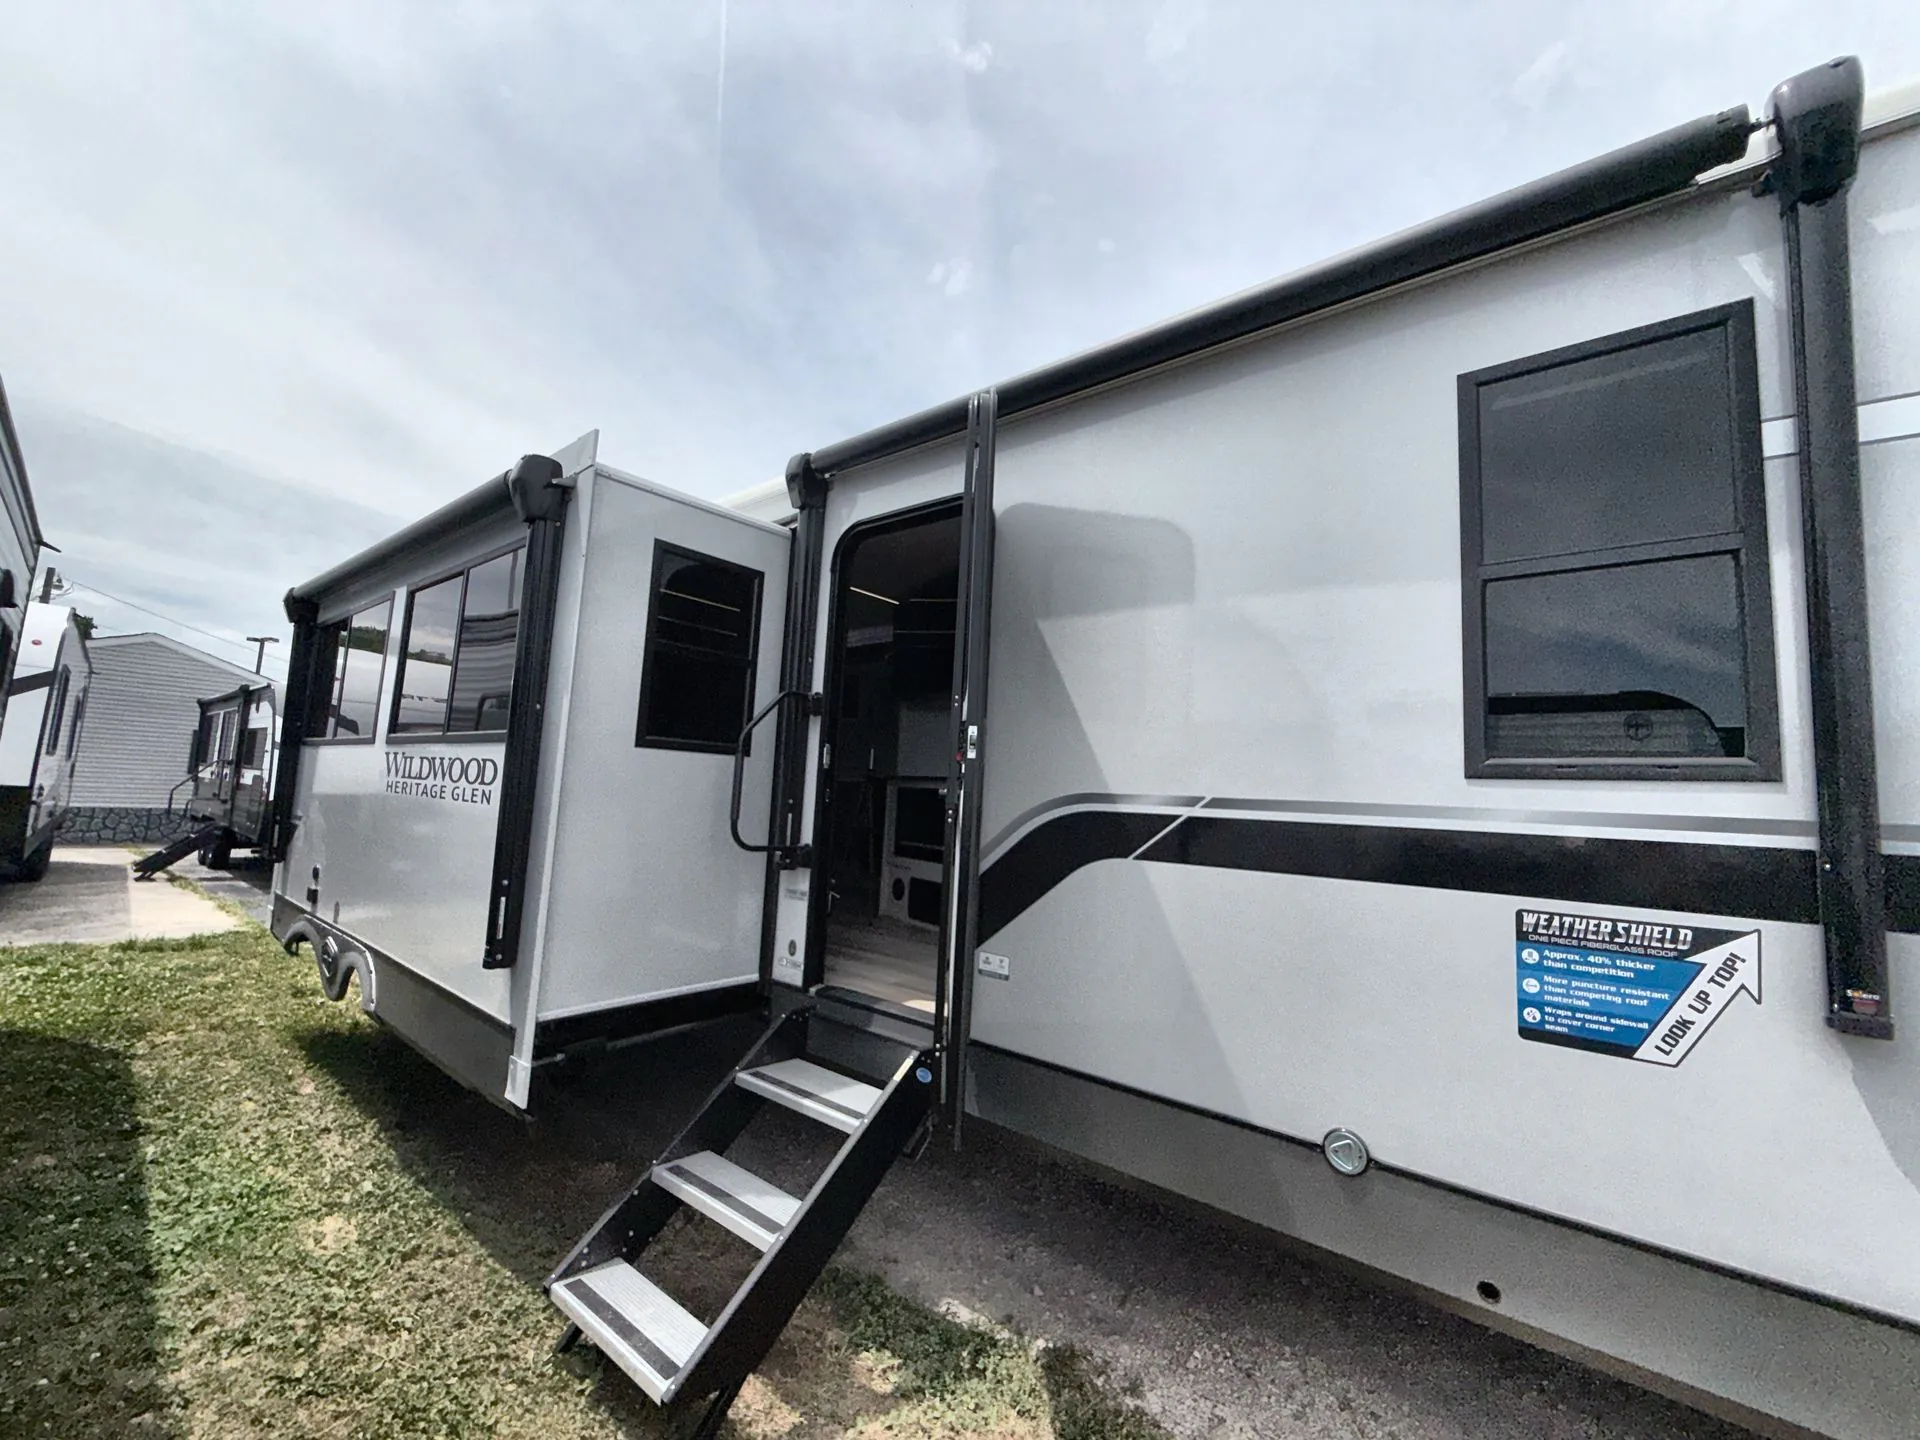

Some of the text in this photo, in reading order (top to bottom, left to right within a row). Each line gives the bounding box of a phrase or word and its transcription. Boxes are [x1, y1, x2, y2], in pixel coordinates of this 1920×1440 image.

[385, 752, 498, 786] WILDWOOD
[386, 780, 492, 805] HERITAGE GLEN
[1521, 912, 1693, 951] WEATHER SHIELD
[1528, 934, 1678, 958] ONE PIECE FIBERGLASS ROOF
[1543, 949, 1656, 971] Approx. 40% thicker
[1543, 959, 1635, 978] than competition
[1543, 975, 1670, 1001] More puncture resistant
[1544, 985, 1649, 1006] than competing roof
[1544, 995, 1590, 1007] materials
[1654, 952, 1747, 1056] LOOK UP TOP!
[1544, 1006, 1649, 1029] Wraps around sidewall
[1545, 1024, 1568, 1033] seam
[1557, 1017, 1582, 1027] cover
[1585, 1022, 1615, 1032] corner
